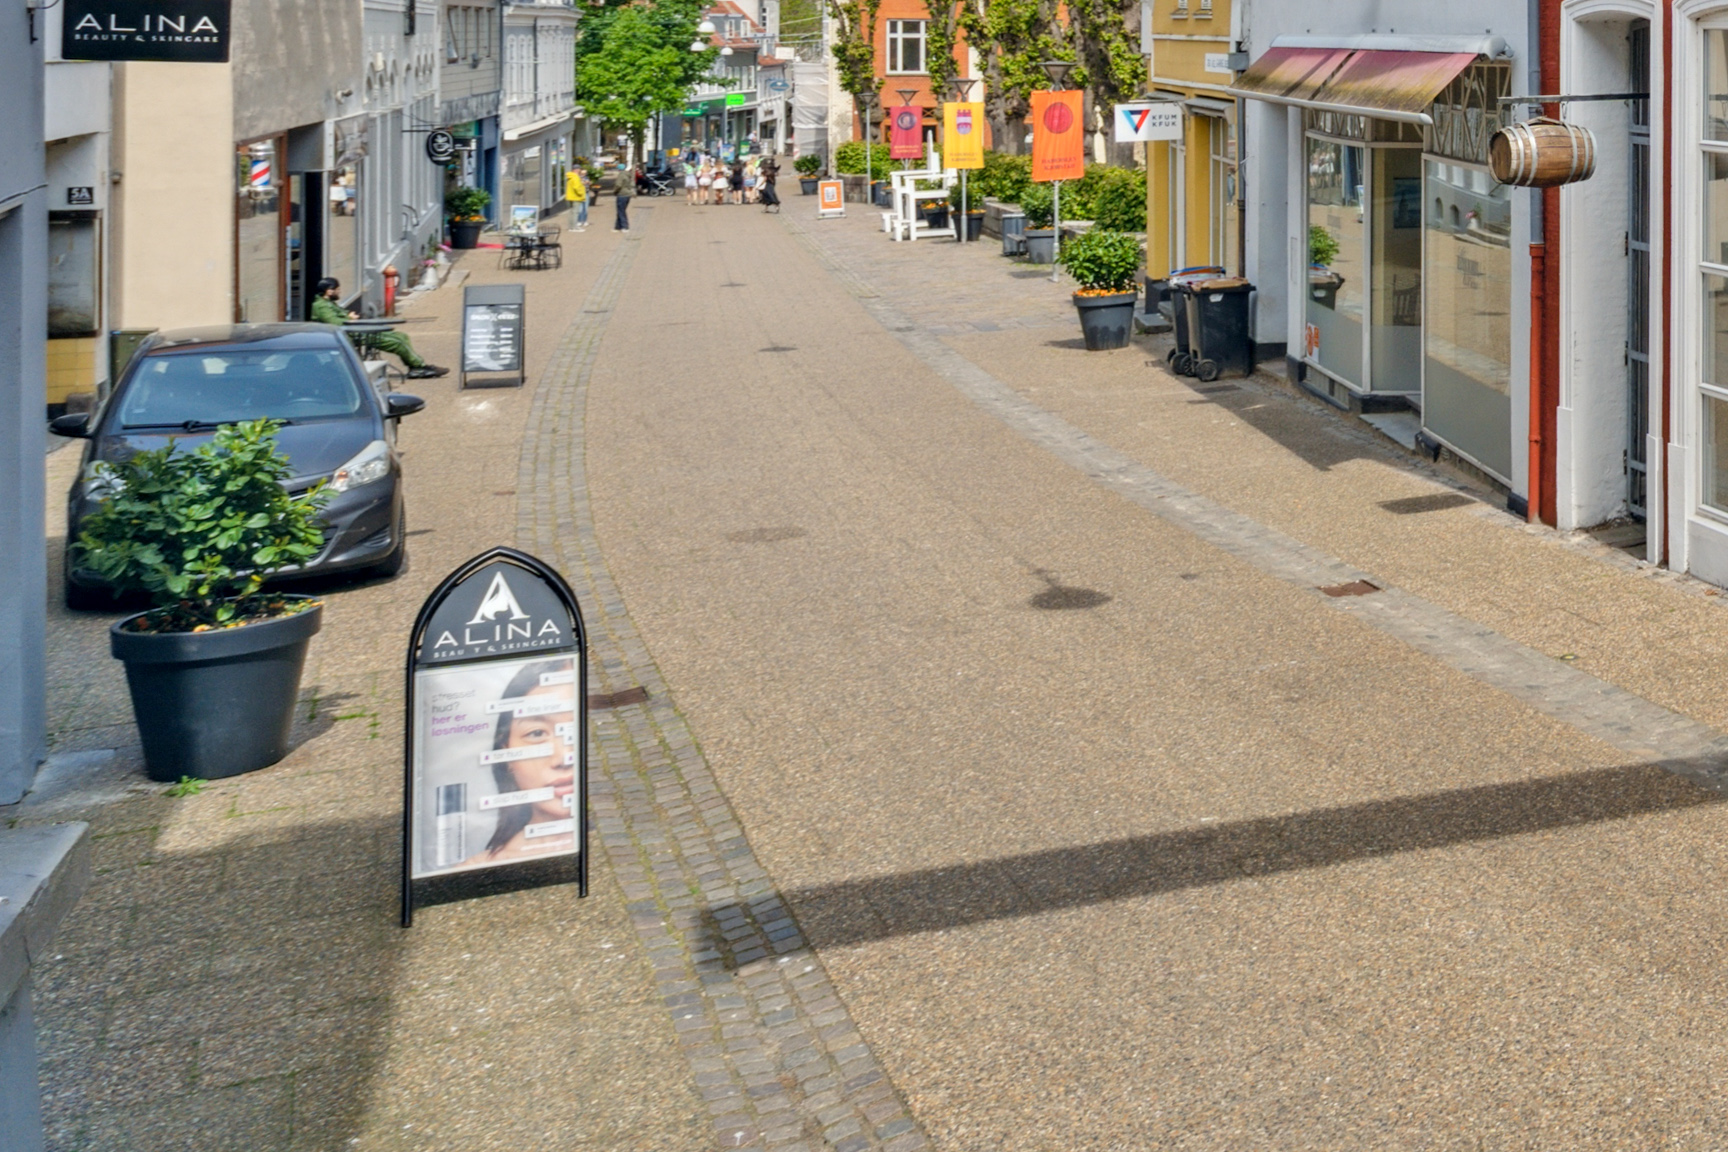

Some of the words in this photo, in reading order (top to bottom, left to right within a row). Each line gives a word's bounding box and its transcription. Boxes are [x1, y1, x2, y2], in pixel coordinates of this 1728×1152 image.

[74, 12, 220, 34] ALINA
[74, 33, 128, 42] BEAUTY
[151, 34, 219, 44] SKINCARE
[434, 619, 561, 649] ALINA
[502, 637, 562, 651] SKINCARE
[432, 715, 452, 726] her
[454, 713, 468, 722] er
